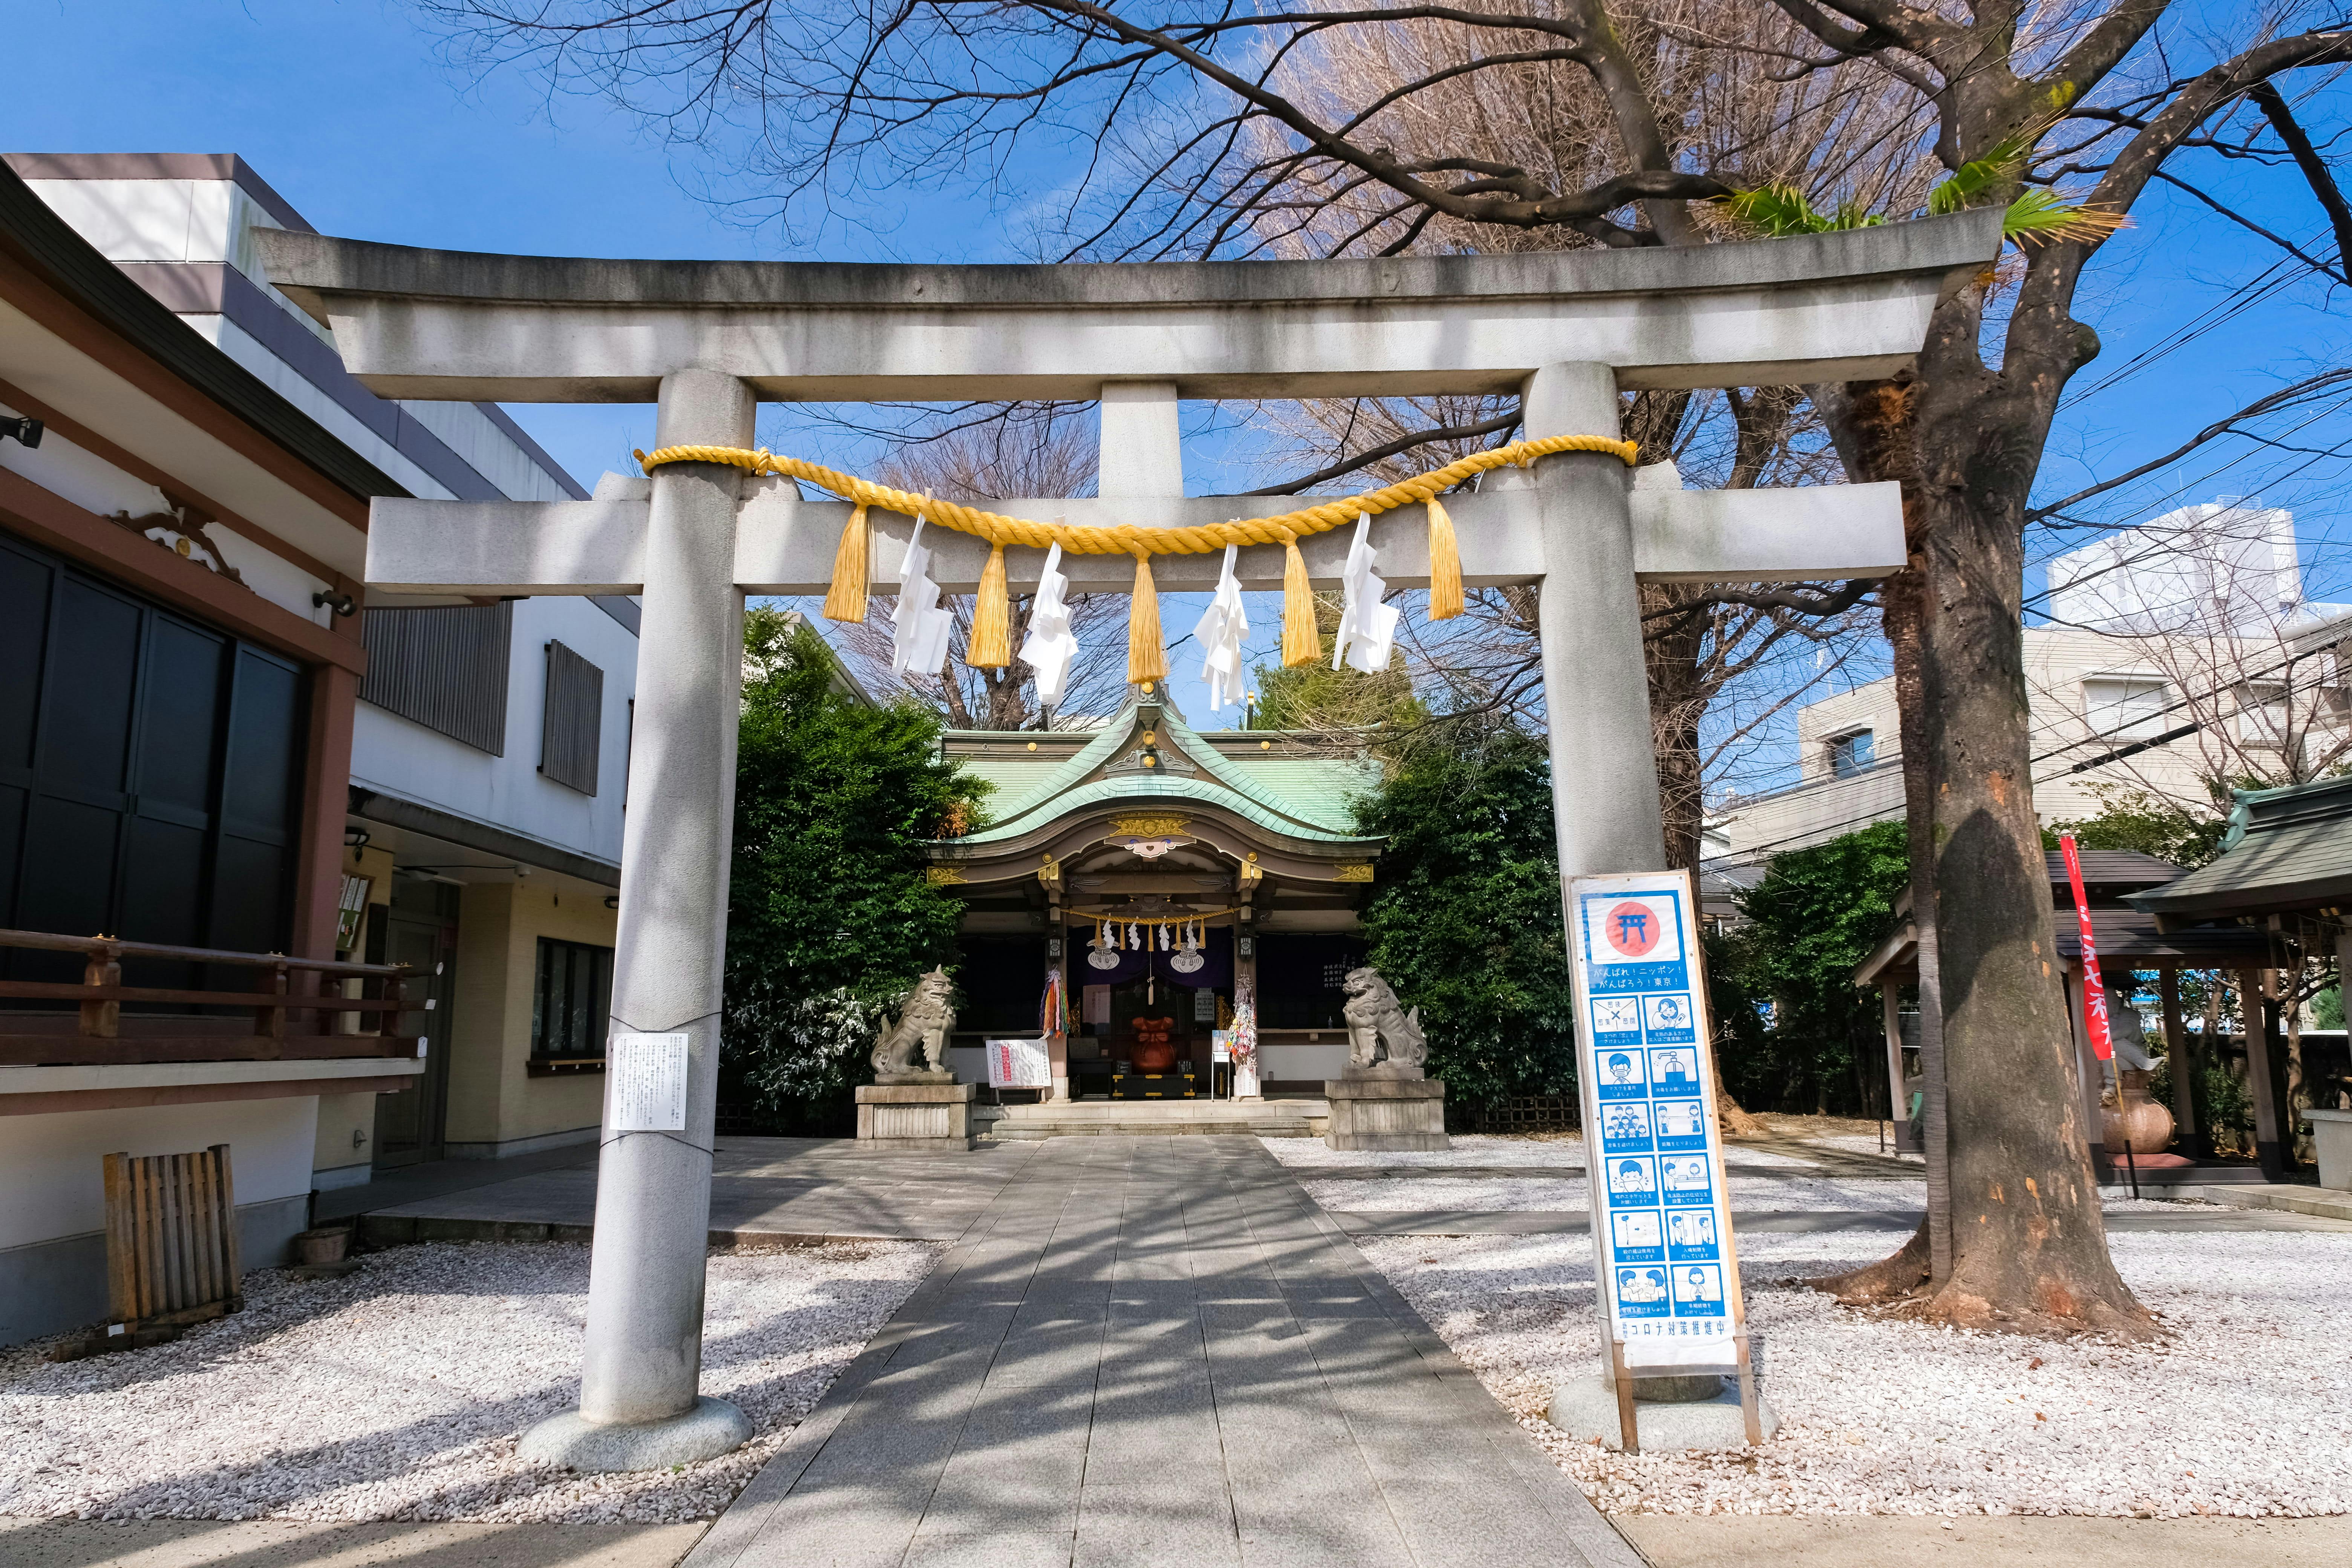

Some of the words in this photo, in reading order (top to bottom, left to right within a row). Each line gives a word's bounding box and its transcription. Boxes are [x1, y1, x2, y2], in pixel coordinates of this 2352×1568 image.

[1599, 977, 1678, 988] がんばろう！東京！
